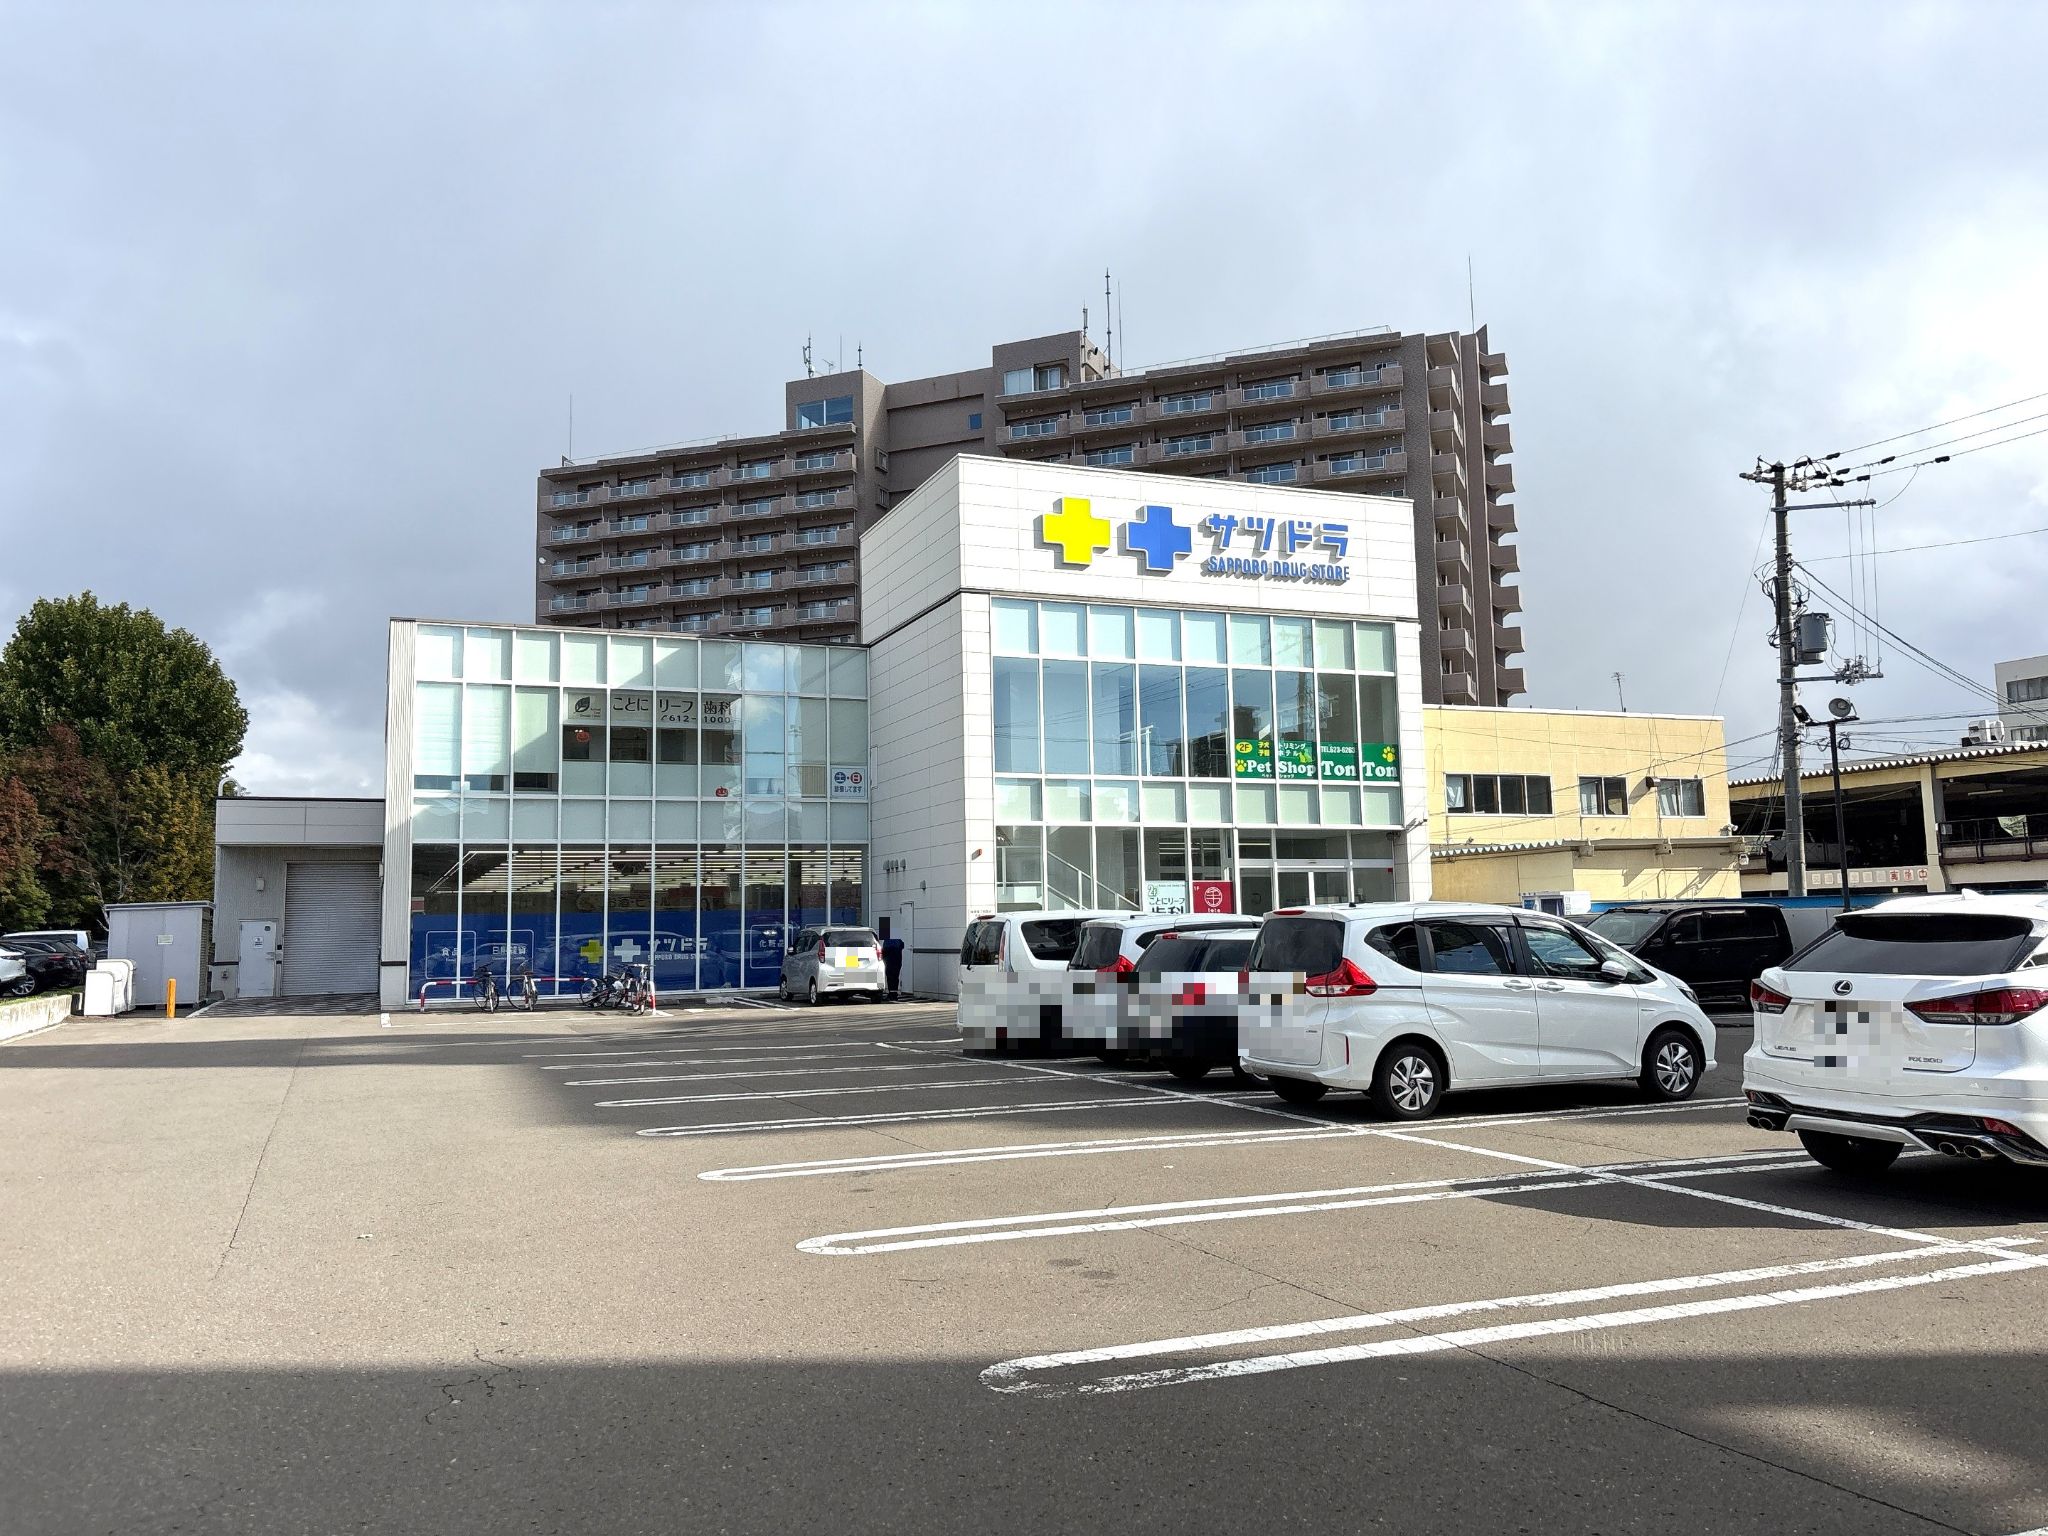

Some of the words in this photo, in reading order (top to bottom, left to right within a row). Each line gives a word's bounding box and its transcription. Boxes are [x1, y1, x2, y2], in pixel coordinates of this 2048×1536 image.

[1206, 513, 1349, 558] サツドラ
[1207, 555, 1269, 576] SAPPORO
[1271, 559, 1308, 578] DRUG
[1310, 563, 1350, 581] STORE
[613, 697, 649, 711] ことに
[659, 699, 693, 713] リーフ
[703, 701, 732, 715] 歯科
[1239, 743, 1250, 752] 2F
[1247, 760, 1272, 773] Pet
[1279, 761, 1316, 777] Shop
[1321, 761, 1357, 776] Ton
[1362, 762, 1397, 777] Ton
[1149, 897, 1185, 905] ことにリーフ
[441, 947, 458, 957] 食品
[647, 938, 708, 952] サツドラ
